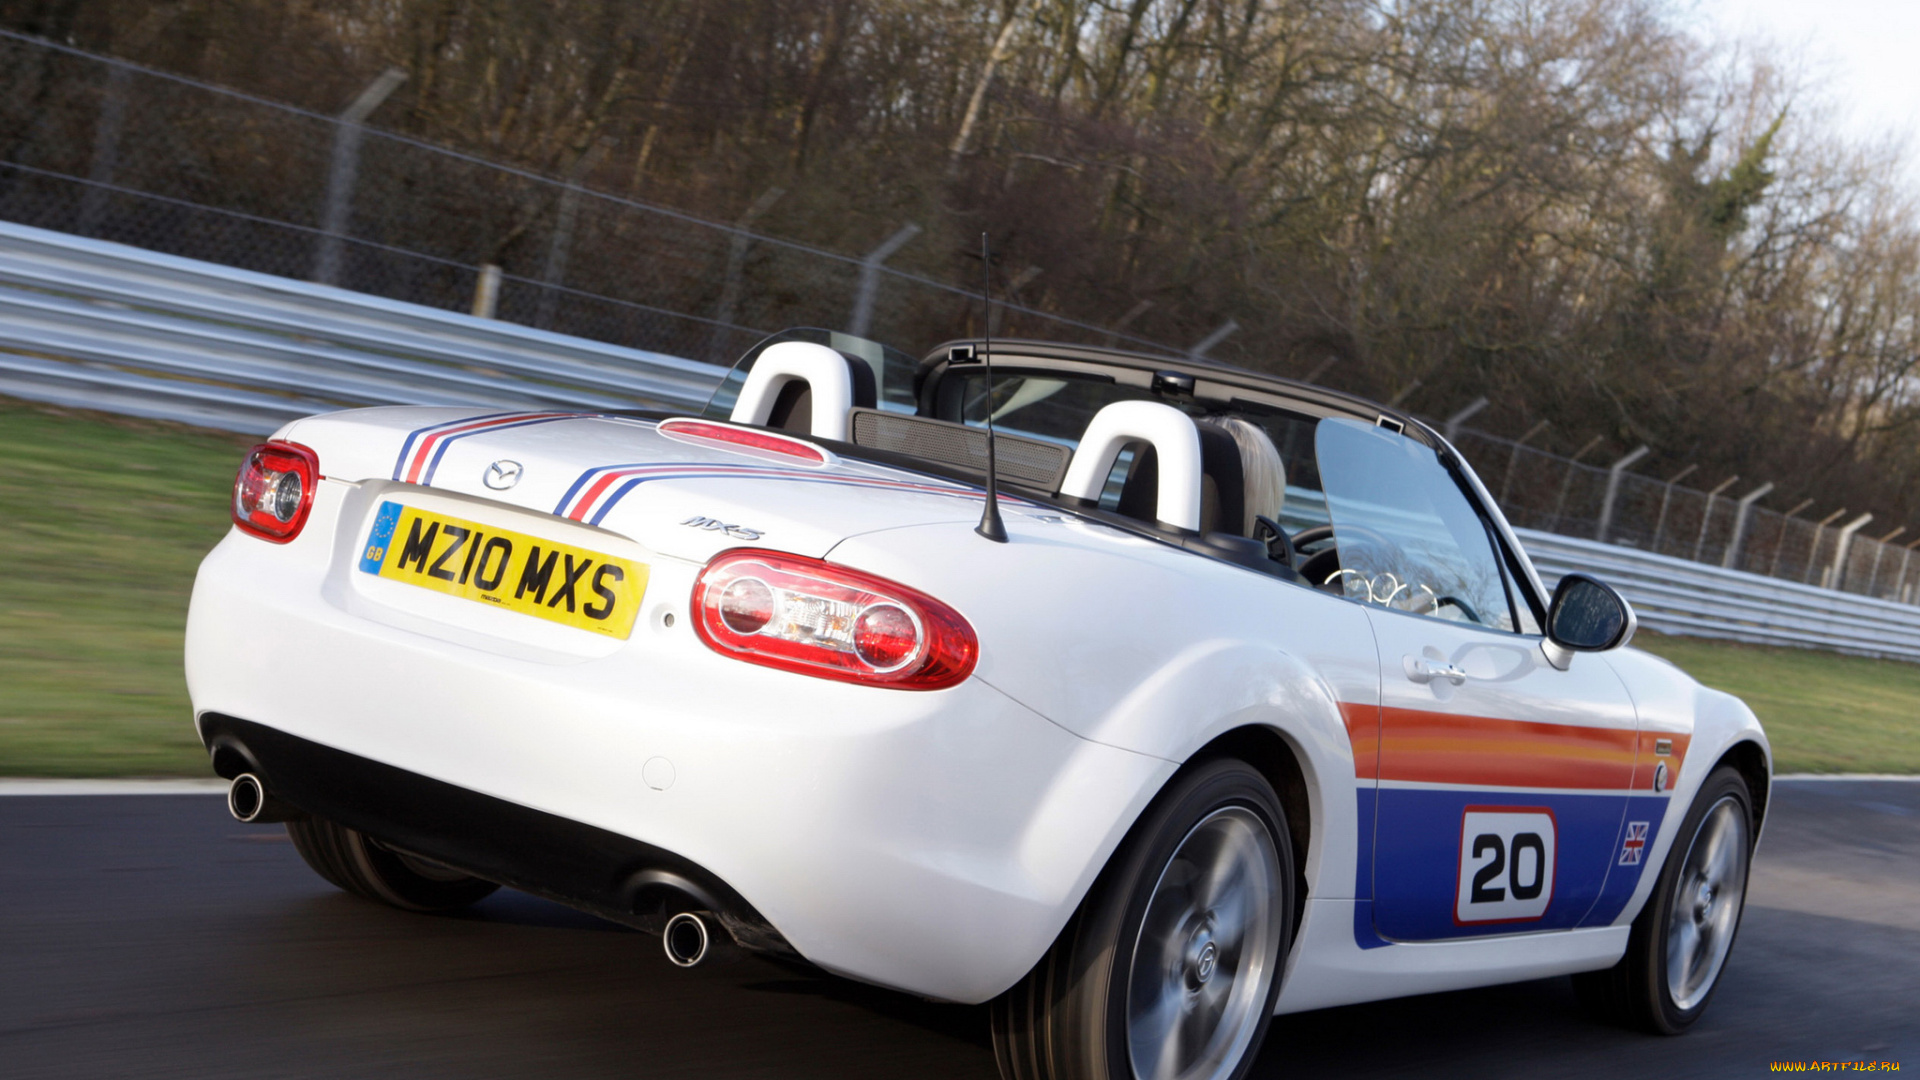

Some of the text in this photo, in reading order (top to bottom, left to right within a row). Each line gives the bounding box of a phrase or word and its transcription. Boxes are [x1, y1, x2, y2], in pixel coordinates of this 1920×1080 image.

[366, 546, 383, 560] GB
[397, 517, 625, 621] MZ10 MXS
[1470, 832, 1546, 904] 20
